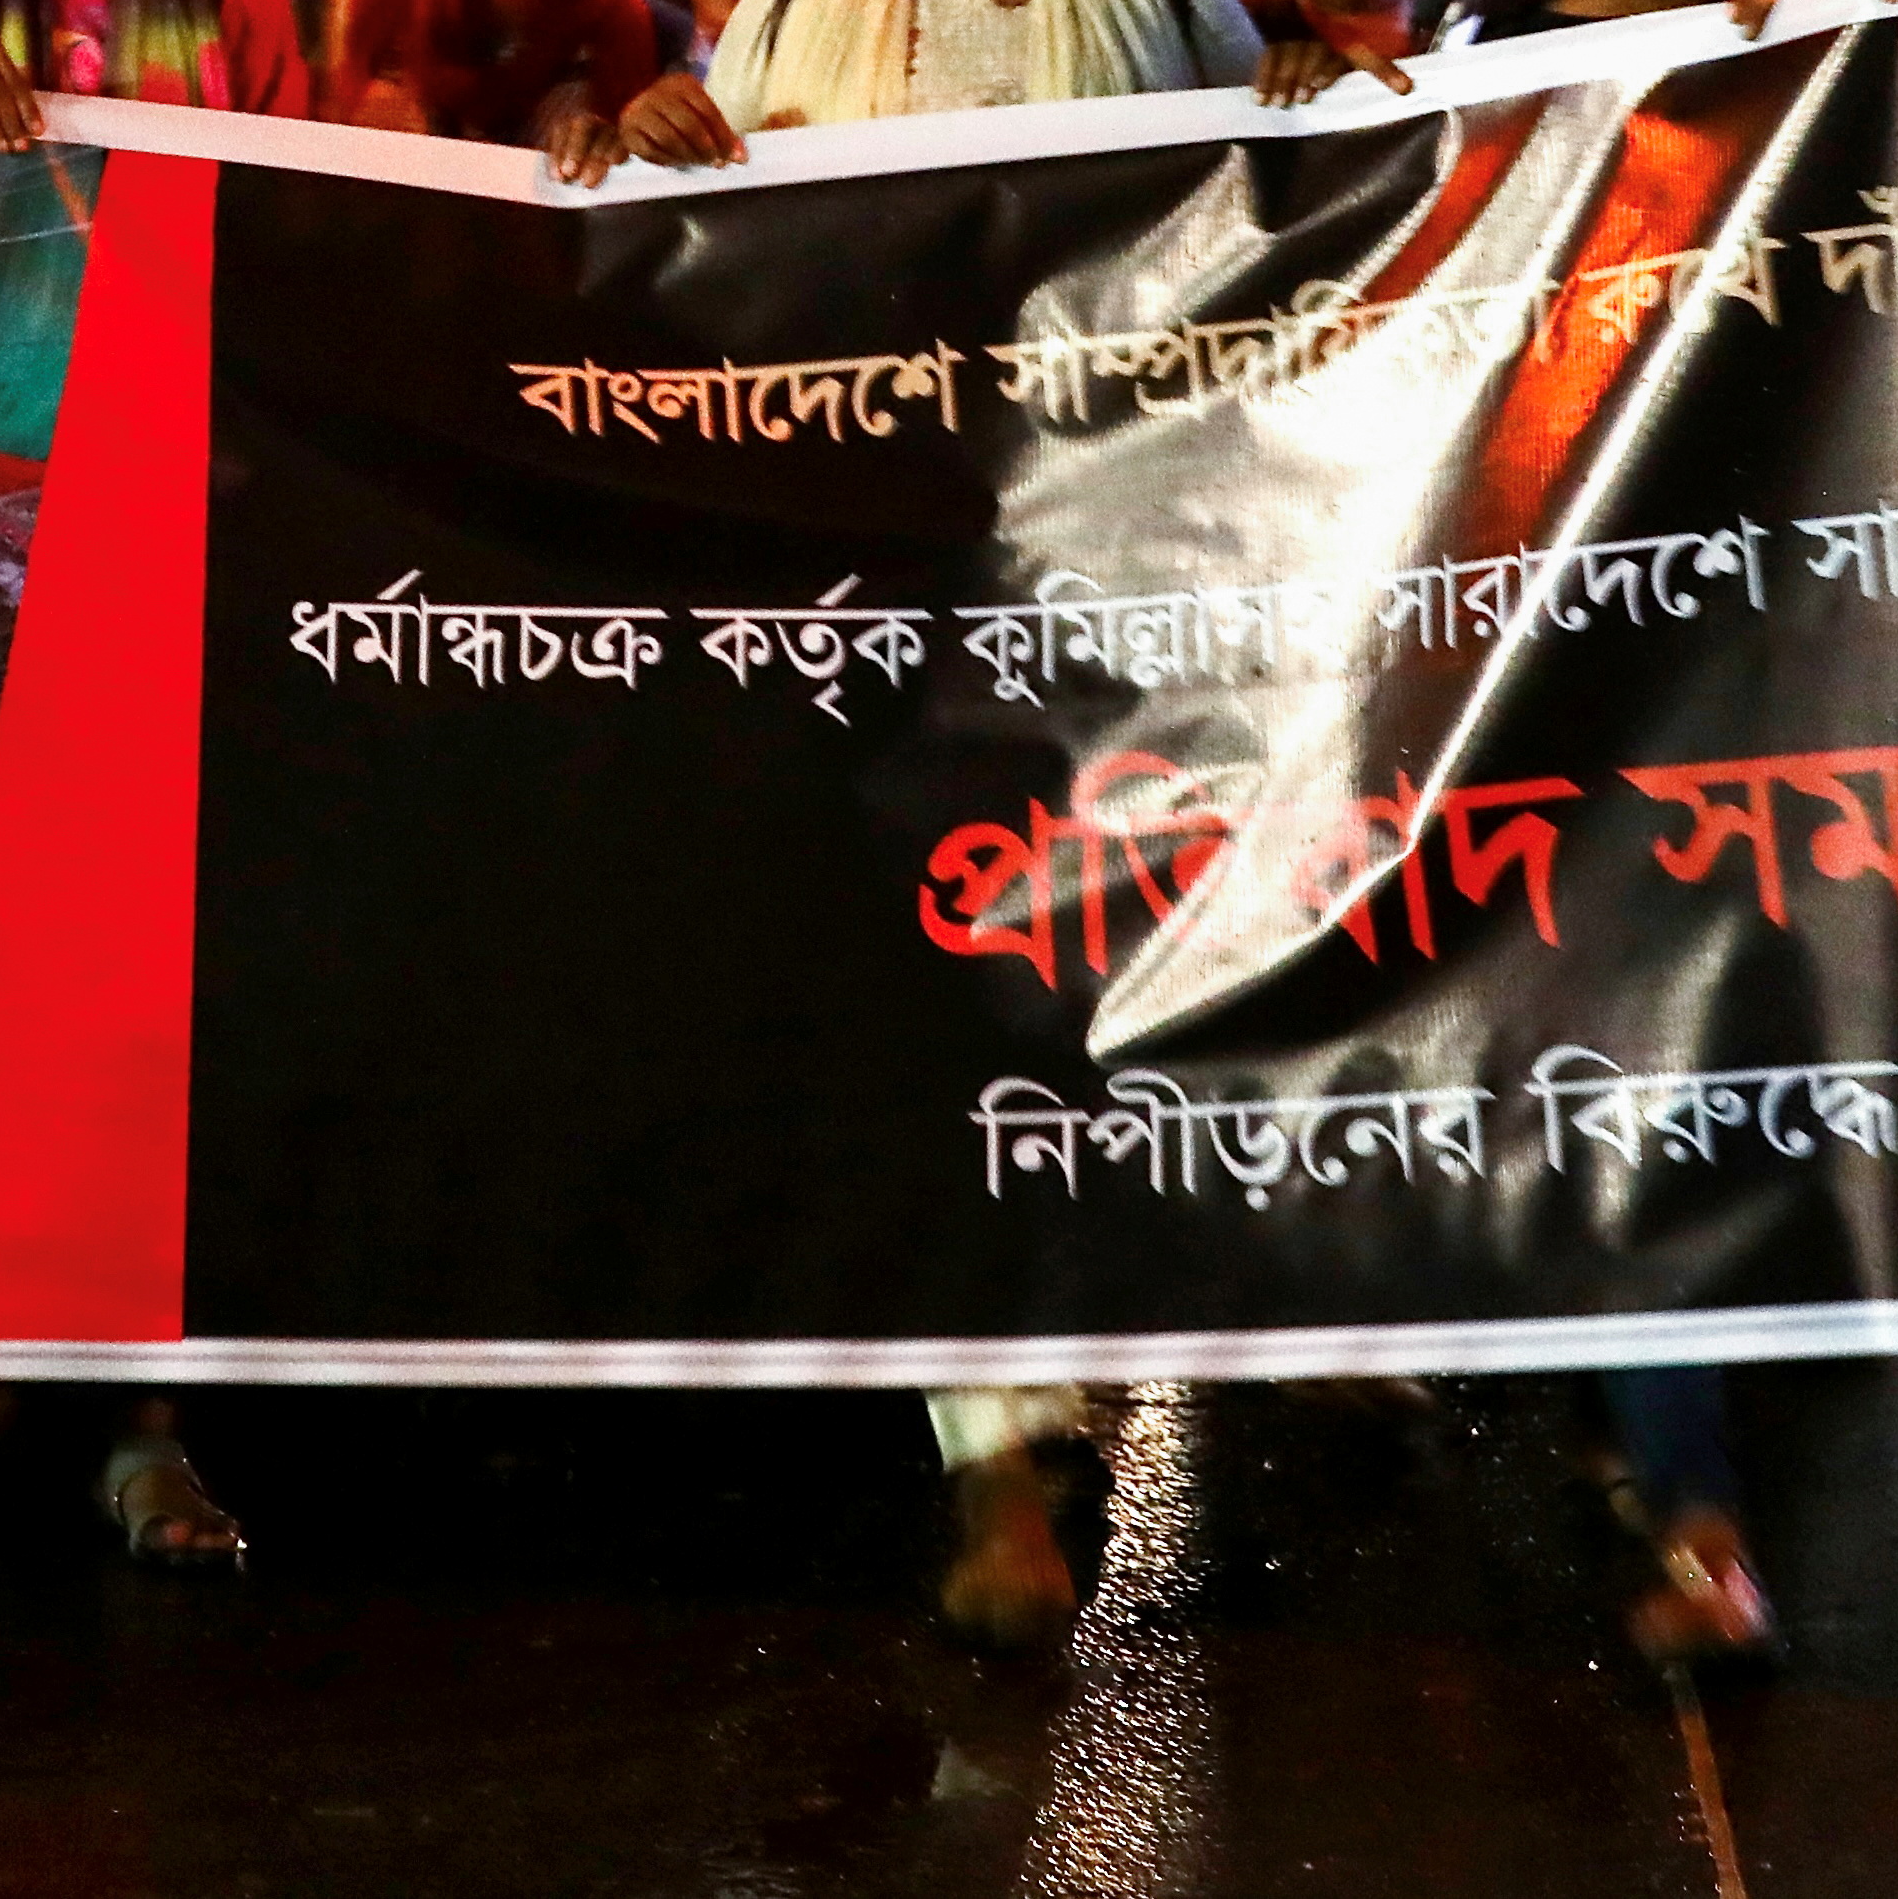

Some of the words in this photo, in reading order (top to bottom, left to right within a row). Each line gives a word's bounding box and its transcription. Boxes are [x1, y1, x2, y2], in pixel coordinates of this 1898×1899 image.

[510, 339, 967, 442] বাংলাদেশে
[291, 569, 670, 691] ধর্মান্ধচক্র
[689, 574, 933, 728] কর্তৃক
[968, 1067, 1497, 1211] নিপীড়নের
